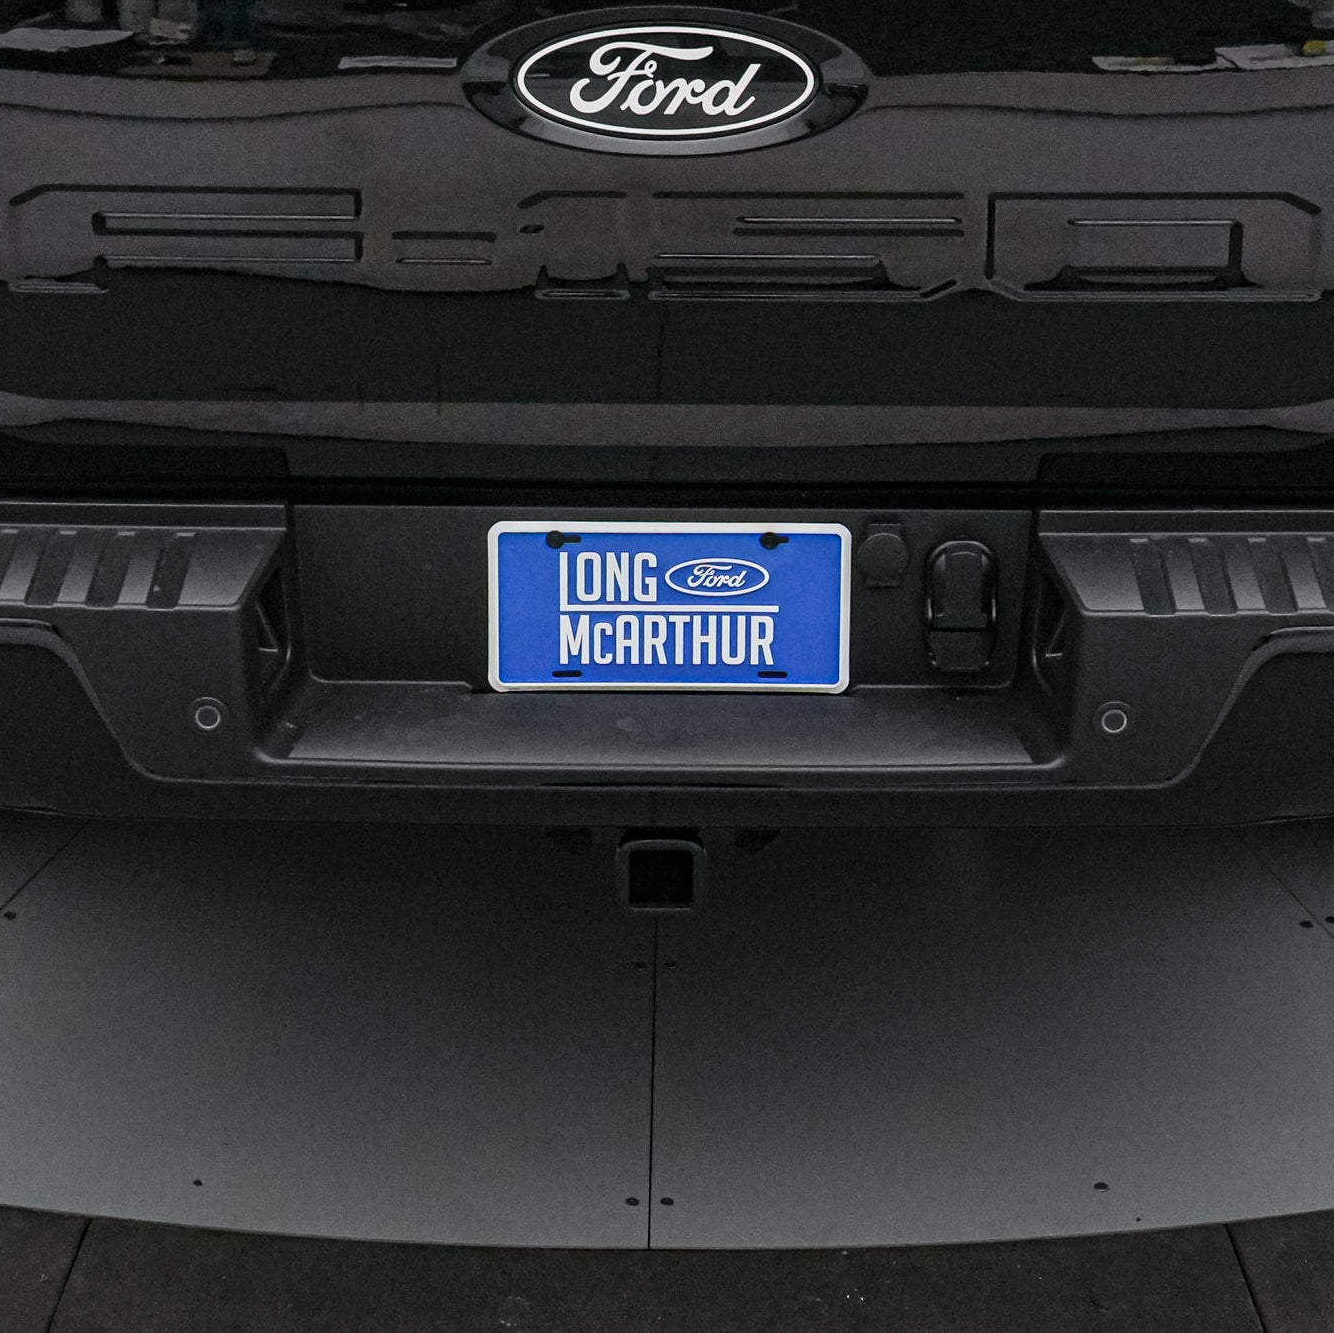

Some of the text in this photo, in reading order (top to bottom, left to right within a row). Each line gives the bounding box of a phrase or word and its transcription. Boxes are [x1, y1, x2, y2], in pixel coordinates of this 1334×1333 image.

[569, 41, 762, 116] Ford
[7, 185, 1324, 302] F-150
[559, 551, 746, 610] LONG Ford
[559, 614, 775, 665] McARTHUR
